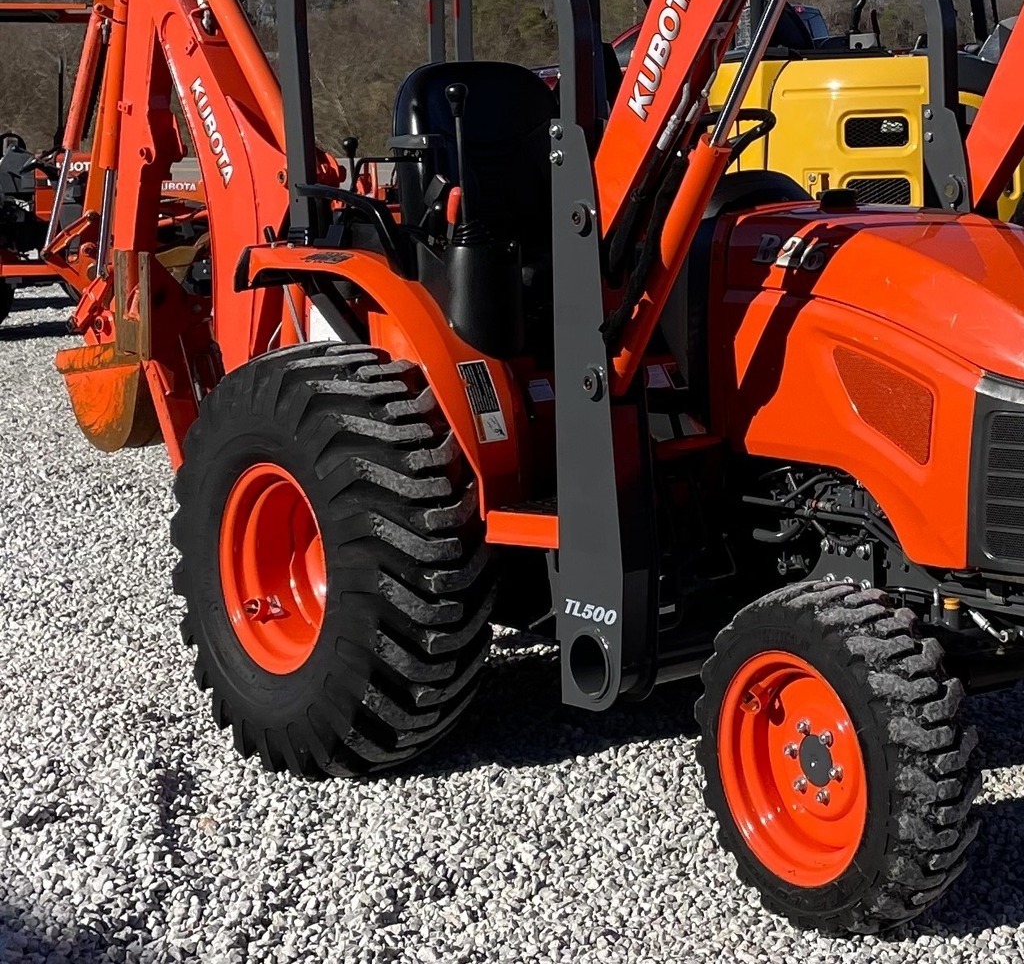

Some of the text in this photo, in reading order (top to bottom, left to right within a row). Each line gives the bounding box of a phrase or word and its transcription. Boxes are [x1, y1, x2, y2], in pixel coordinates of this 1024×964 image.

[190, 76, 234, 189] KUBOTA
[161, 182, 197, 192] UBOTA
[752, 233, 830, 271] B26
[564, 598, 618, 626] TL500
